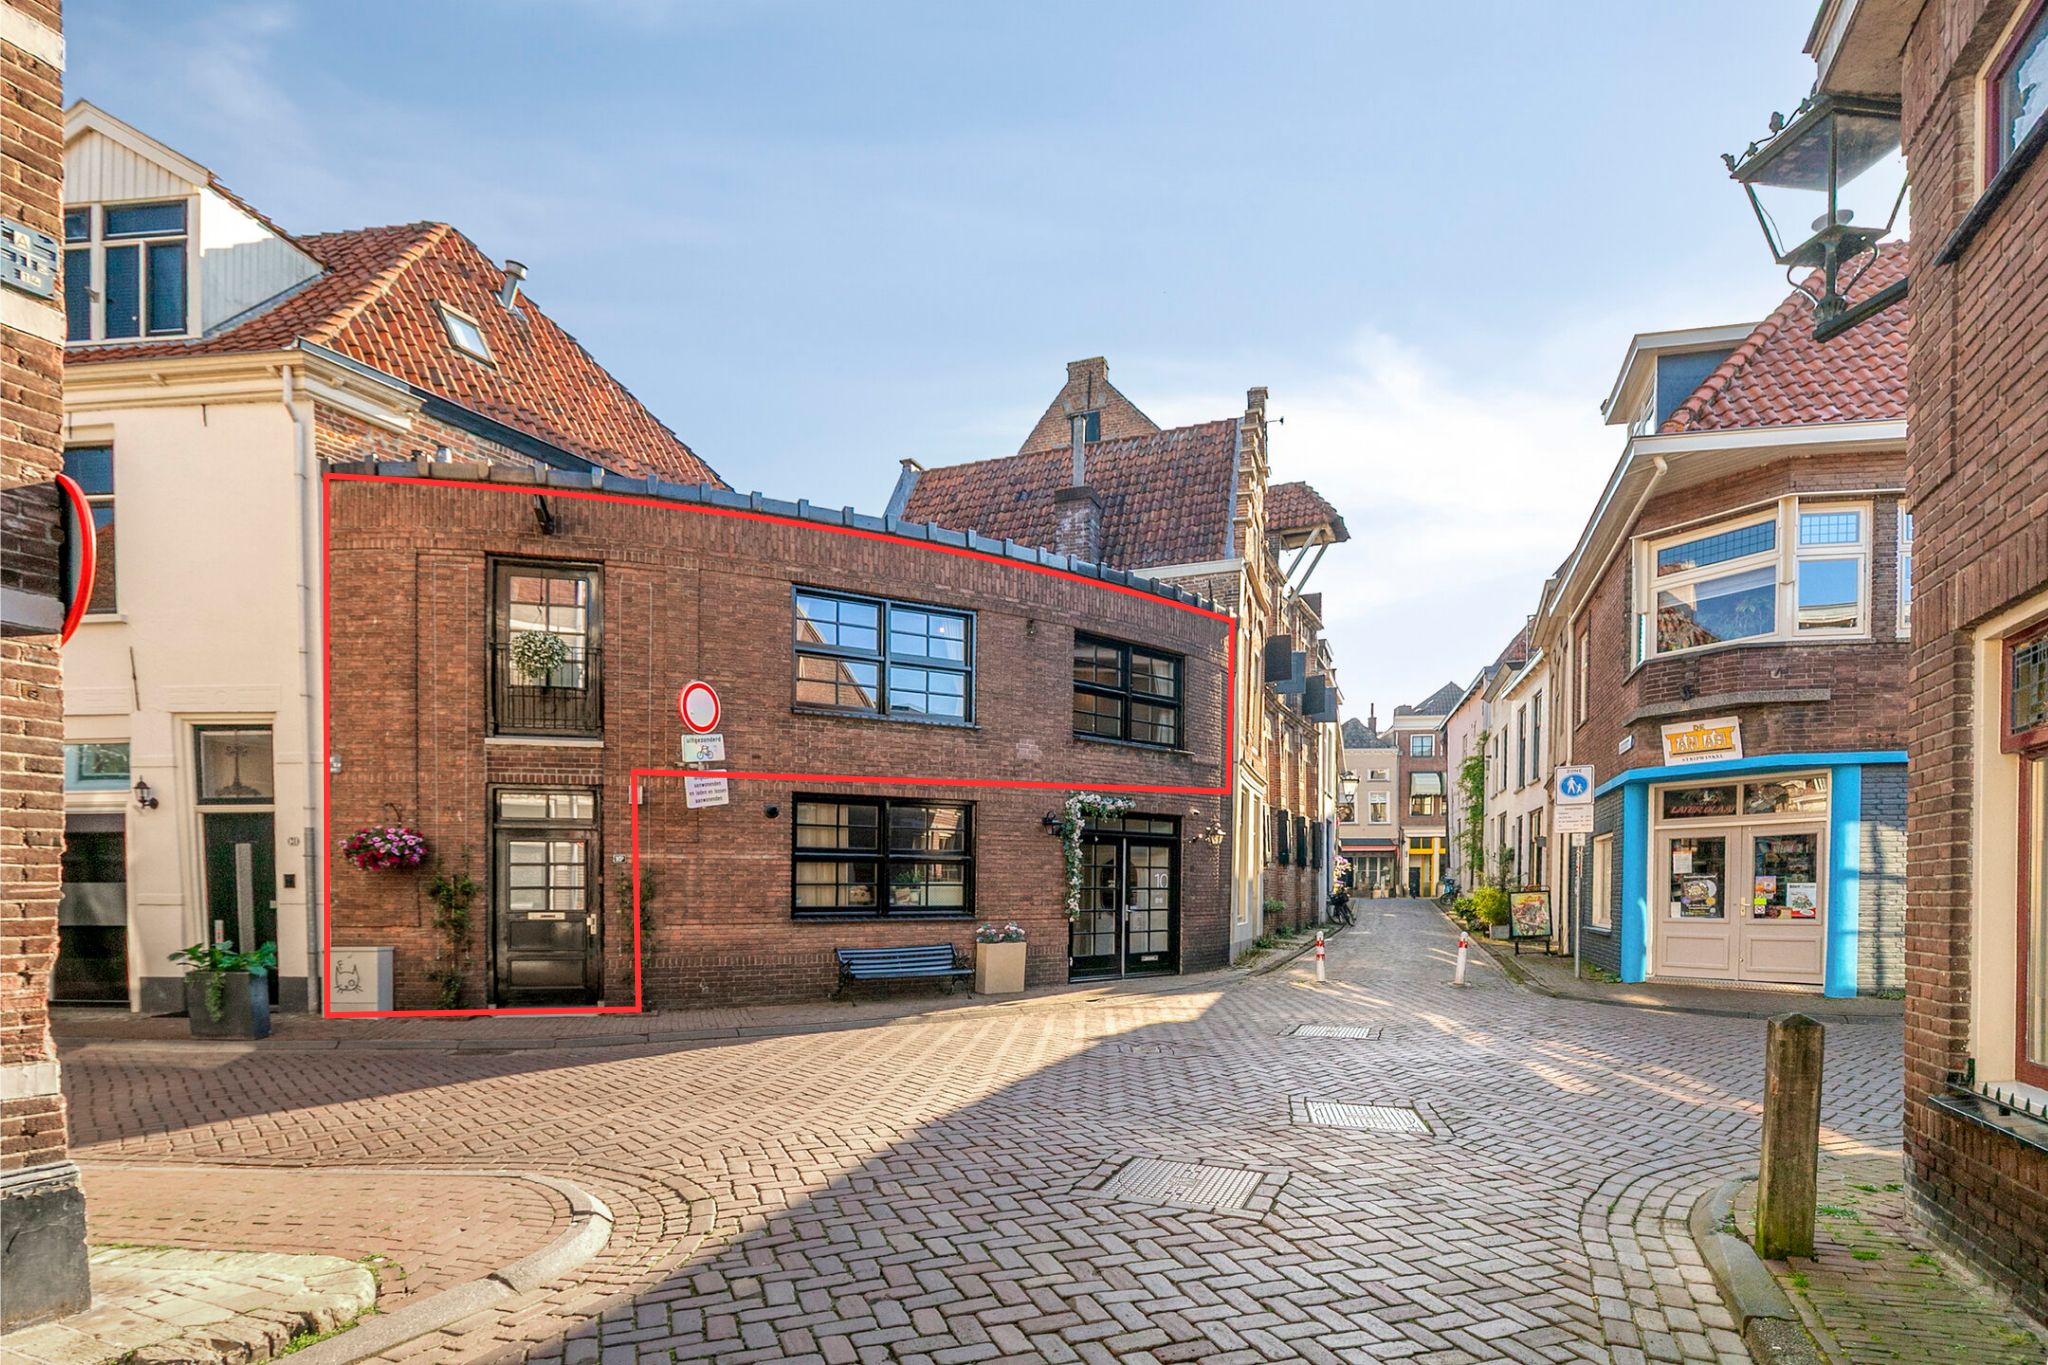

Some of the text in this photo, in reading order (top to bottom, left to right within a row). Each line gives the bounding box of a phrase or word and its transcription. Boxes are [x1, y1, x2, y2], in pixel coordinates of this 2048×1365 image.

[686, 736, 721, 744] uitgezonderd
[1682, 754, 1723, 762] STRIPWINKEL
[1154, 873, 1168, 888] 10
